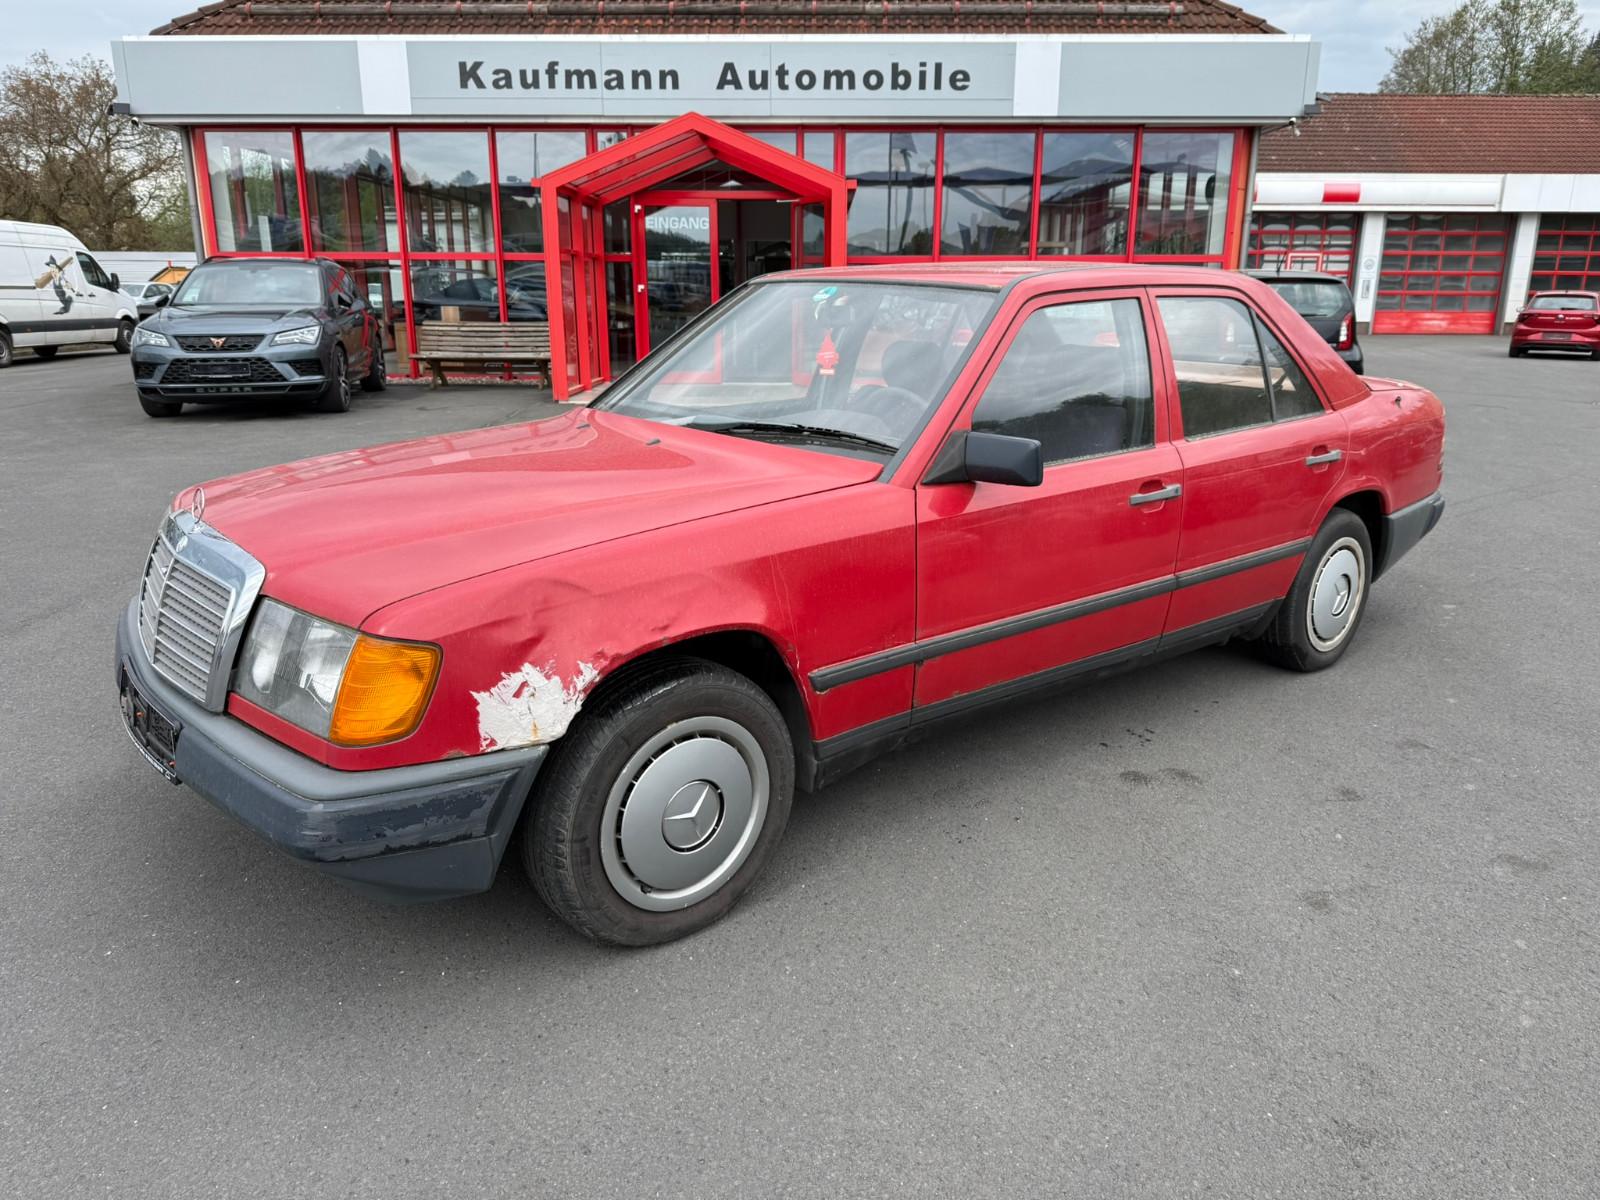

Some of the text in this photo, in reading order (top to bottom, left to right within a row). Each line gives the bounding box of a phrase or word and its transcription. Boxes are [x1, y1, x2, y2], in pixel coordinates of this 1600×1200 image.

[458, 61, 971, 91] Kaufmann Automobile
[645, 216, 709, 230] EINGANG
